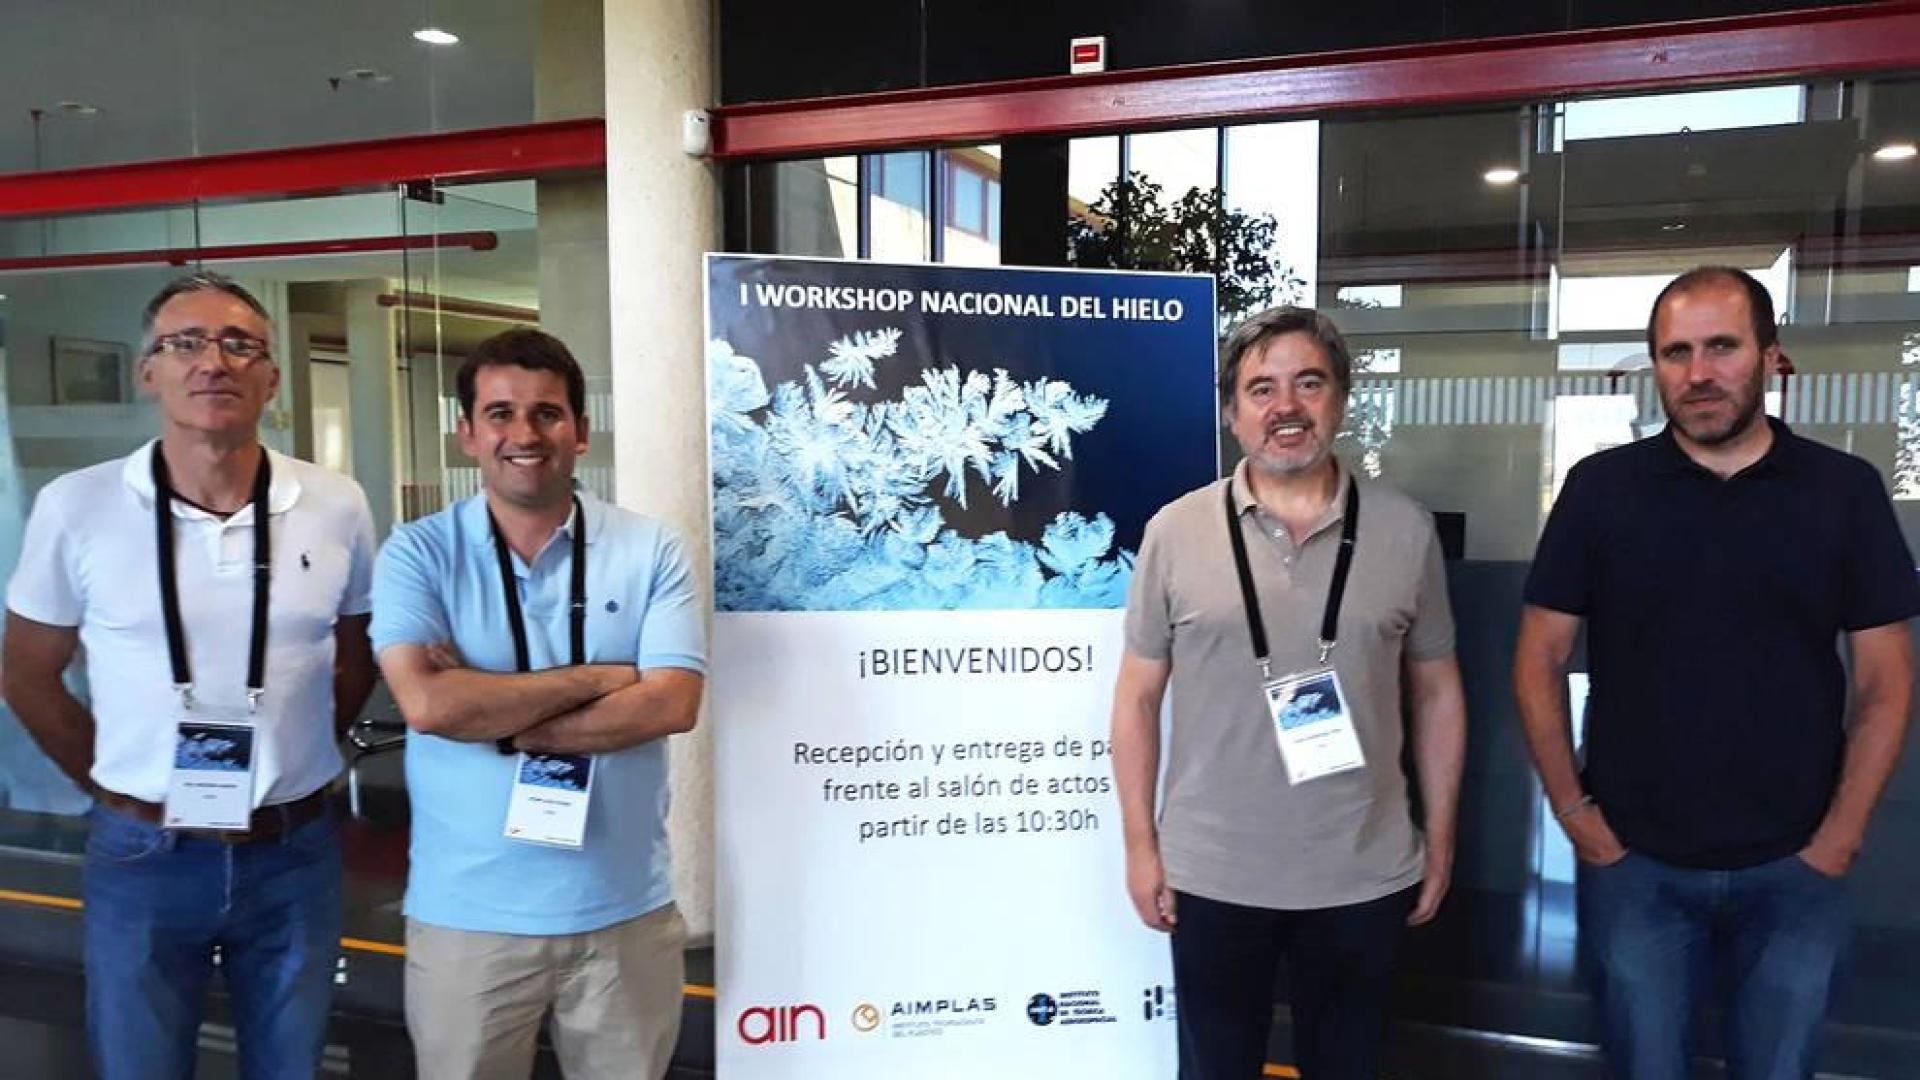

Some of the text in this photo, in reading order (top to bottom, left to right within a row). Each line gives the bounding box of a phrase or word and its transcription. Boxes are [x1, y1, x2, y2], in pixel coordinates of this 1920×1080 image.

[740, 283, 1184, 322] I WORKSHOP NACIONAL DEL HIELO
[860, 645, 1092, 679] ¡BIENVENIDOS!
[794, 735, 1113, 768] Recepción y entrega de pa
[823, 773, 1110, 801] frente al salón de actos
[859, 808, 1099, 844] partir de las 10:30h
[891, 998, 997, 1016] AIMPLAS
[738, 1004, 825, 1045] ain
